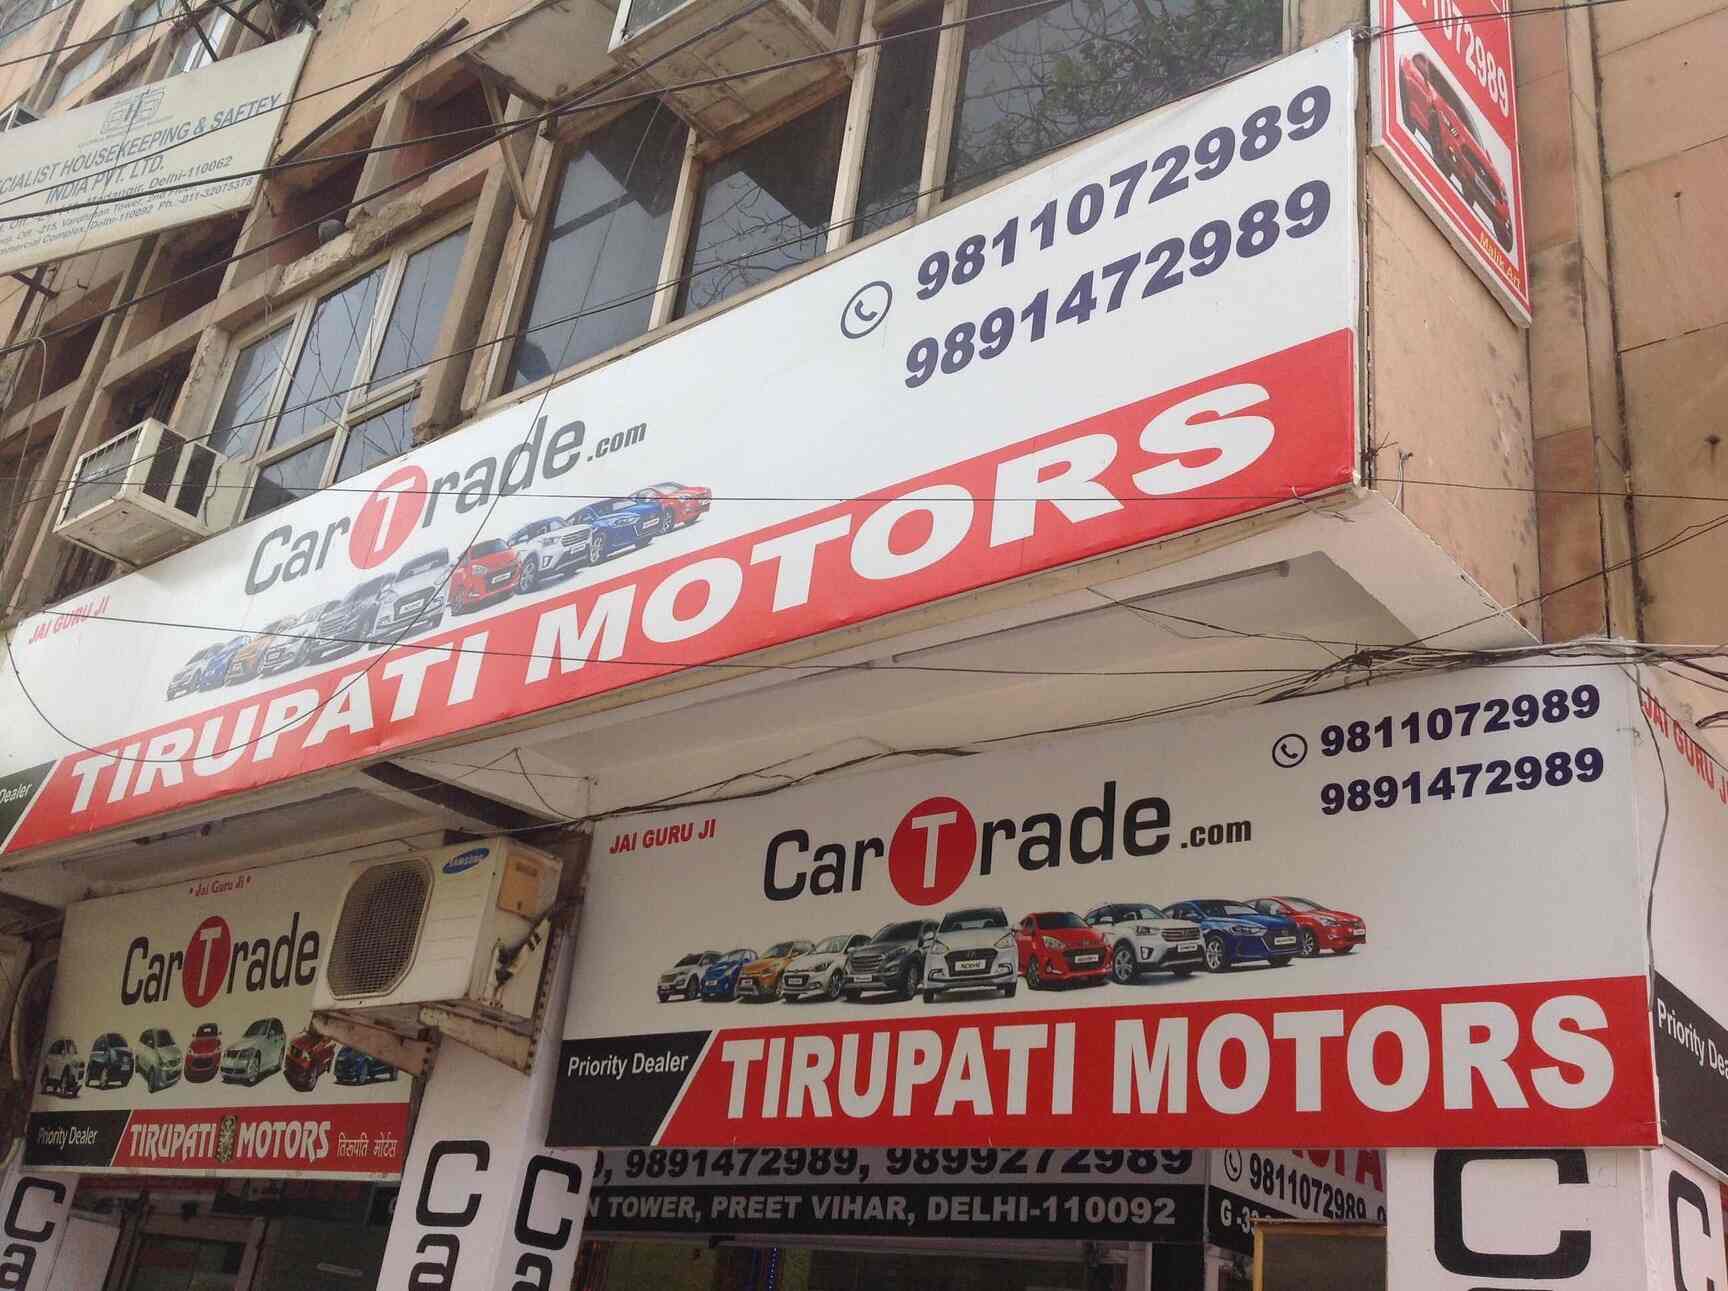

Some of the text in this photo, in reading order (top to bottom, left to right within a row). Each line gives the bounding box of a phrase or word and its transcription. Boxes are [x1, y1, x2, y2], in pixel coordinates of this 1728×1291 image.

[60, 121, 191, 177] HOUSEKEEPING
[193, 116, 207, 136] &
[916, 85, 1331, 300] 9811072989
[904, 179, 1331, 389] 9891472989
[70, 382, 1276, 815] TIRUPATI MOTORS
[1320, 684, 1601, 758] 9811072989
[1320, 746, 1605, 816] 9891472989
[609, 818, 717, 855] JAI GURU JI
[121, 912, 320, 1006] CarTrade
[567, 1053, 690, 1081] Priority Dealer
[719, 994, 1616, 1120] TIRUPATI MOTORS
[1657, 997, 1705, 1067] Priority
[37, 1125, 99, 1151] Priority Dealer
[129, 1120, 331, 1163] TIRUPATI MOTORS
[624, 1148, 871, 1184] 9891472989,
[885, 1148, 1193, 1177] 9899272989
[607, 1195, 702, 1223] TOWER,
[711, 1195, 803, 1220] PREET
[811, 1195, 916, 1226] VIHAR,
[926, 1195, 1176, 1226] DELHI-110092
